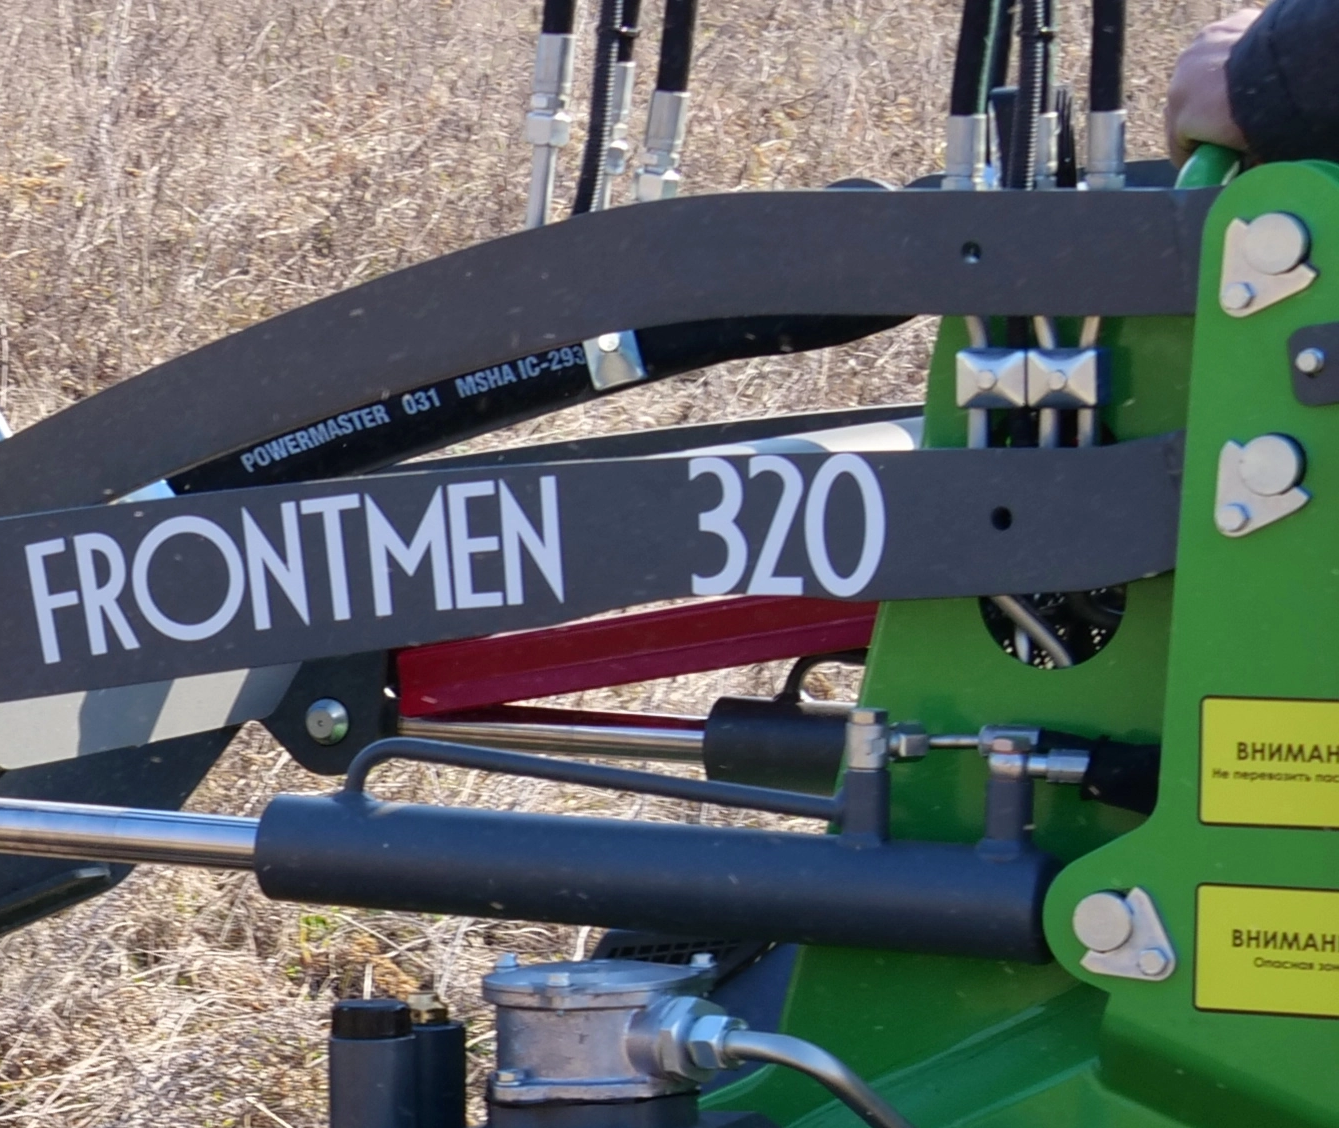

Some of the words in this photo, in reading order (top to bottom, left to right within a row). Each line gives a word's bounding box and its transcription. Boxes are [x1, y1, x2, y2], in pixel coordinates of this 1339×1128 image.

[240, 404, 391, 473] POWERMASTER
[401, 388, 442, 416] 031
[454, 363, 518, 399] MSHA
[24, 475, 565, 664] FRONTMEN
[688, 452, 886, 598] 320
[1210, 768, 1230, 779] Не
[1231, 928, 1339, 953] ВНИМАН
[1253, 956, 1315, 971] Опасная
